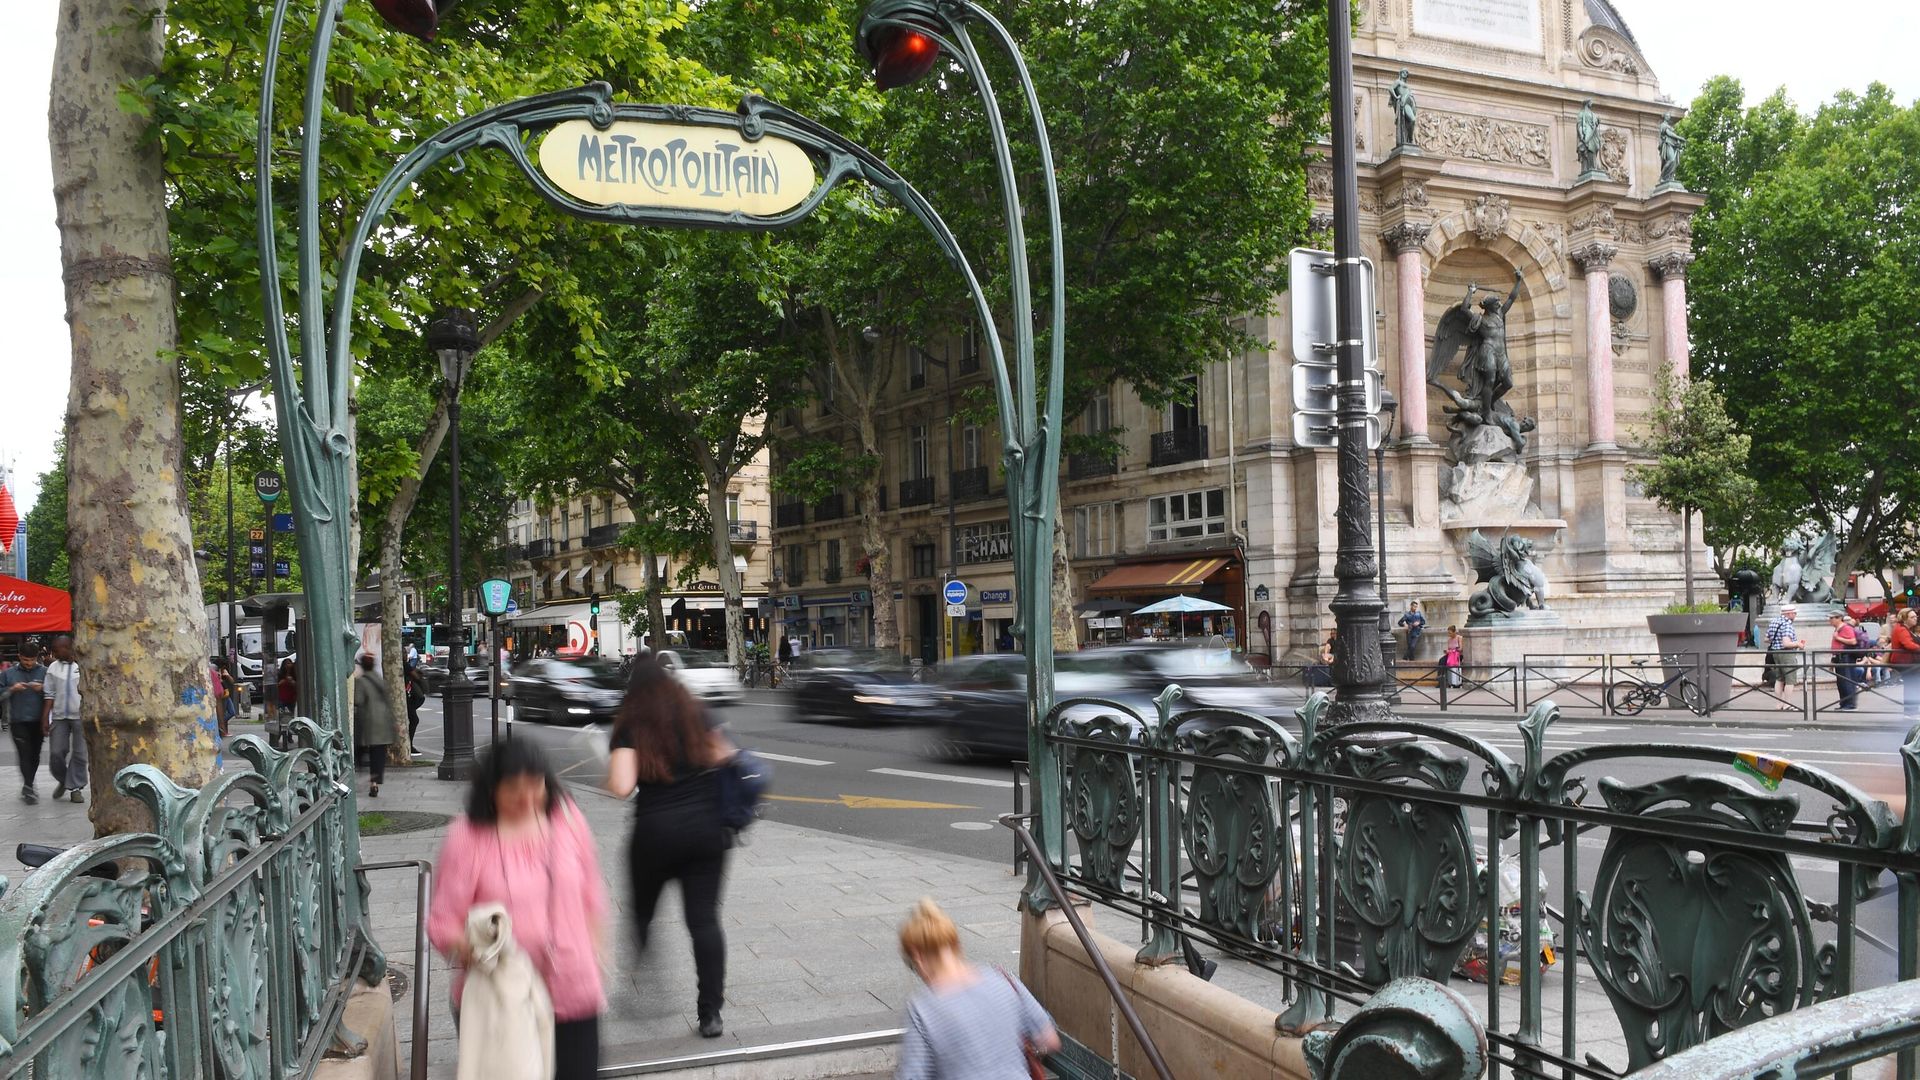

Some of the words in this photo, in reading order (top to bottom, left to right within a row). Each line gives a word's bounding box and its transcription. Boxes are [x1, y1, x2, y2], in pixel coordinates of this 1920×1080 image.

[578, 134, 780, 197] METROPOLITAIN
[258, 477, 279, 488] BUS
[252, 531, 264, 539] 27
[982, 591, 1007, 602] Change
